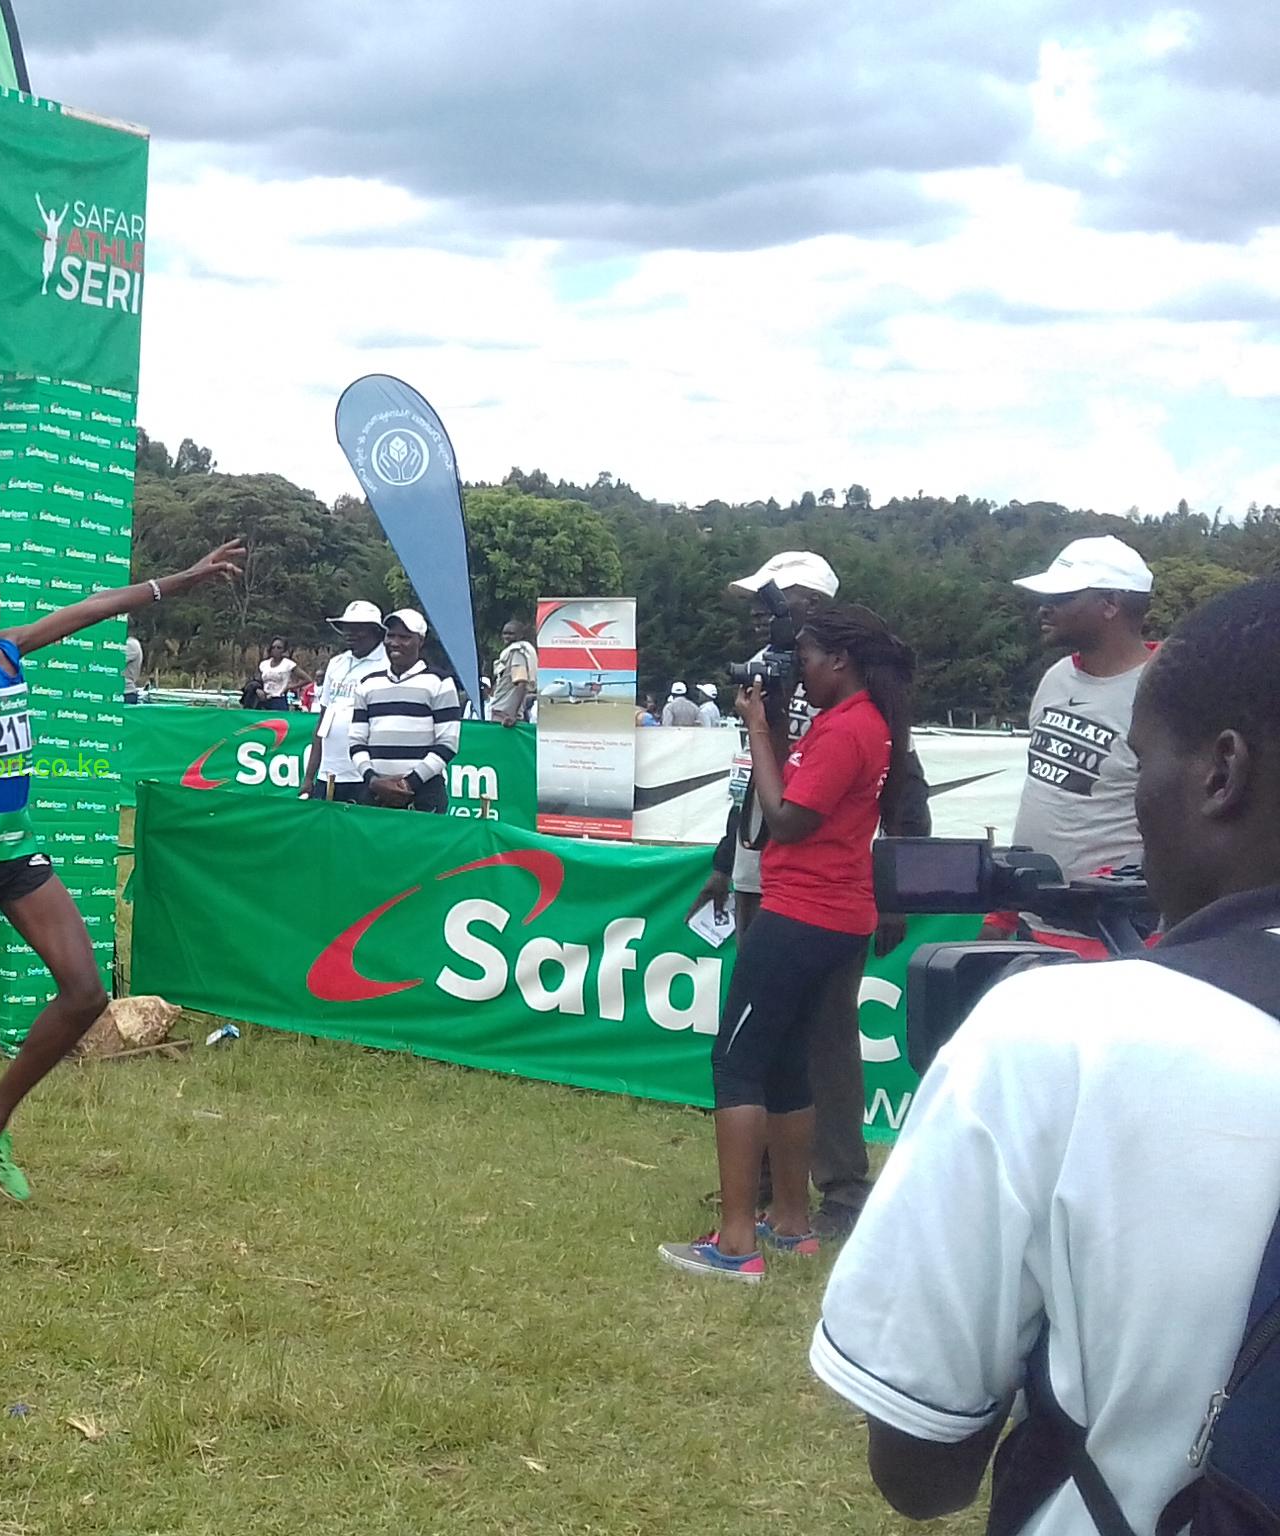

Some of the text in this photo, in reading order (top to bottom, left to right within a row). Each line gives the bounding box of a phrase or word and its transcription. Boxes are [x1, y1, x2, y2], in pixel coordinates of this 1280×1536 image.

[56, 256, 140, 314] SERI
[1042, 711, 1113, 745] NDALAT
[1047, 738, 1072, 758] XC
[1031, 760, 1070, 784] 2017
